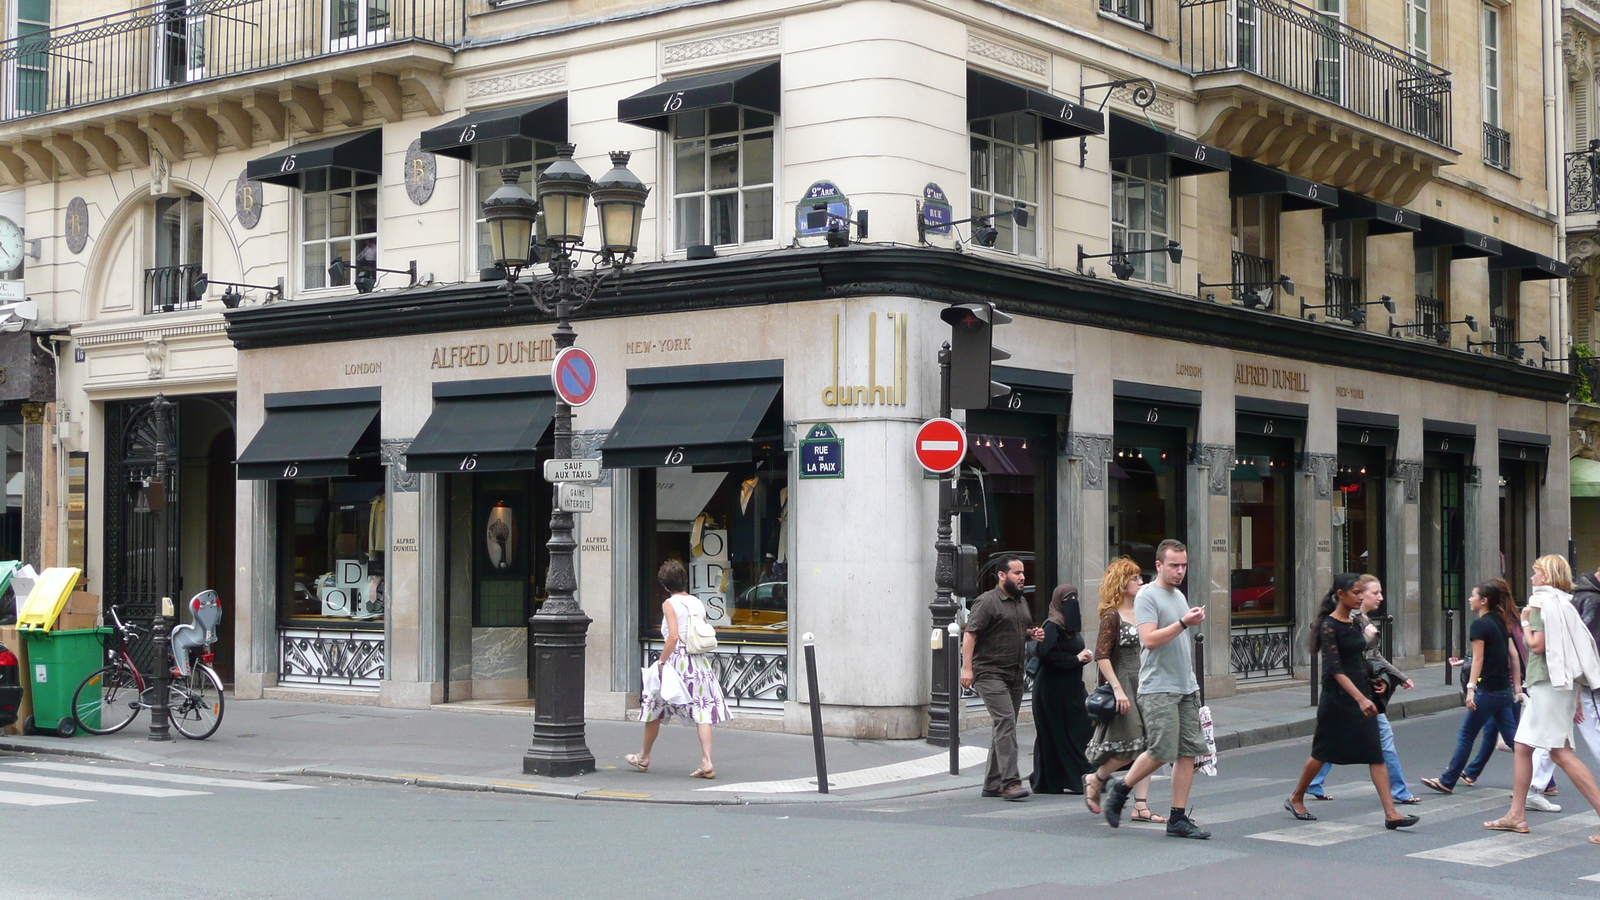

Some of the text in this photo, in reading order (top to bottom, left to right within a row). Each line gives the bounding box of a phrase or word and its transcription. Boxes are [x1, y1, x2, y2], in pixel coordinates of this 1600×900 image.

[663, 91, 684, 111] 15
[1060, 103, 1073, 120] 15
[459, 124, 477, 142] 15
[1195, 145, 1206, 161] 15
[281, 155, 296, 172] 15
[412, 158, 425, 184] B
[242, 186, 254, 210] B
[1308, 184, 1318, 199] 15
[929, 208, 942, 218] RUE
[1394, 210, 1403, 223] 15
[71, 214, 80, 236] B
[1480, 236, 1487, 248] 15
[1549, 260, 1556, 271] 15
[626, 338, 691, 354] NEW-YORK
[430, 339, 555, 369] ALFRED DUNHIL
[822, 312, 907, 405] dunhill
[345, 361, 382, 375] LONDON
[1176, 363, 1202, 377] LONDON
[1234, 364, 1309, 392] ALFRED DUNHILL
[1008, 392, 1021, 409] 15
[1147, 407, 1158, 422] 15
[1263, 420, 1273, 434] 15
[1360, 430, 1369, 443] 15
[814, 446, 828, 454] RUE
[1441, 438, 1449, 451] 15
[664, 447, 684, 464] 15
[1519, 448, 1526, 459] 15
[283, 462, 299, 477] 15
[460, 454, 477, 470] 15
[564, 462, 582, 470] SAUF
[807, 462, 835, 472] LA PAIX
[555, 470, 592, 479] AUX TAXIS
[570, 488, 585, 497] GAINE
[564, 499, 590, 509] INTERDITE
[345, 563, 362, 584] D
[326, 590, 347, 611] O
[706, 596, 724, 621] S
